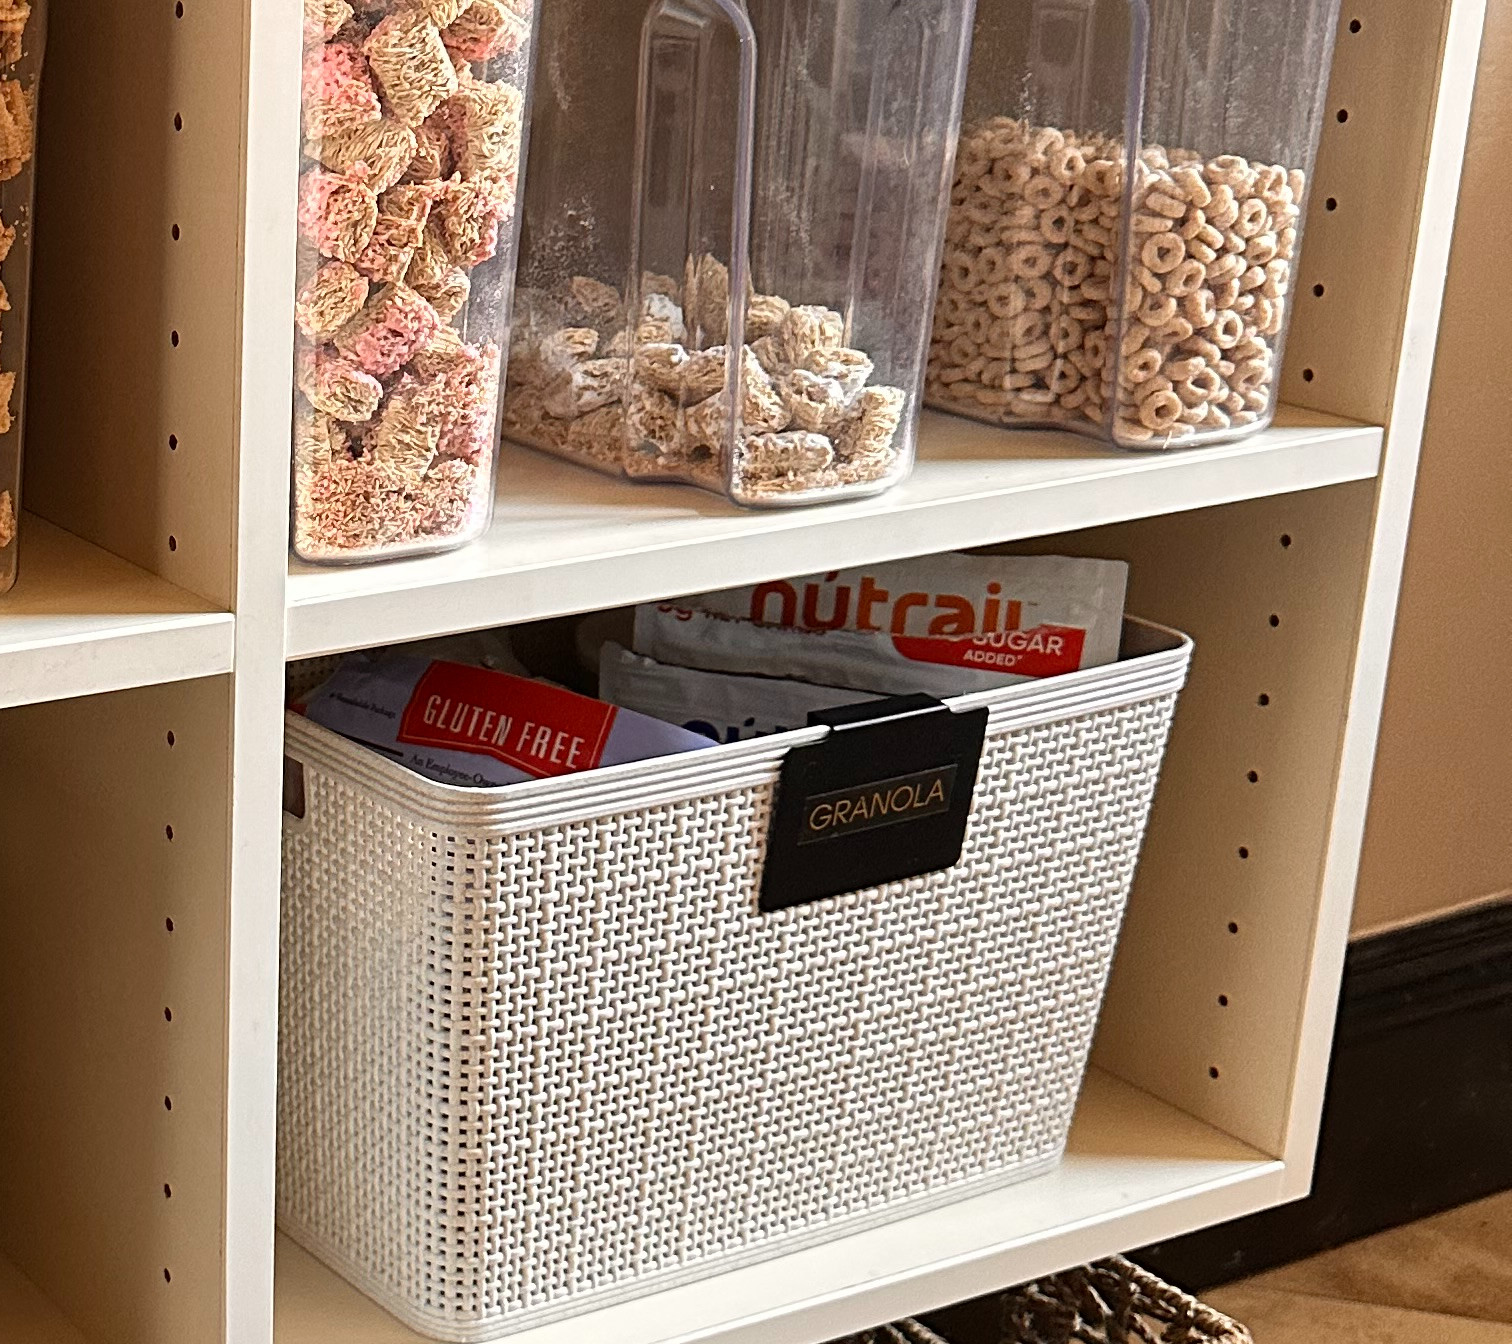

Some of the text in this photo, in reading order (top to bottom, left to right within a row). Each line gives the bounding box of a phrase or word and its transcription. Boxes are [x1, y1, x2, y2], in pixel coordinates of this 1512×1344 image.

[422, 694, 513, 747] GLUTEN
[515, 721, 585, 769] FREE
[809, 778, 944, 831] GRANOLA
